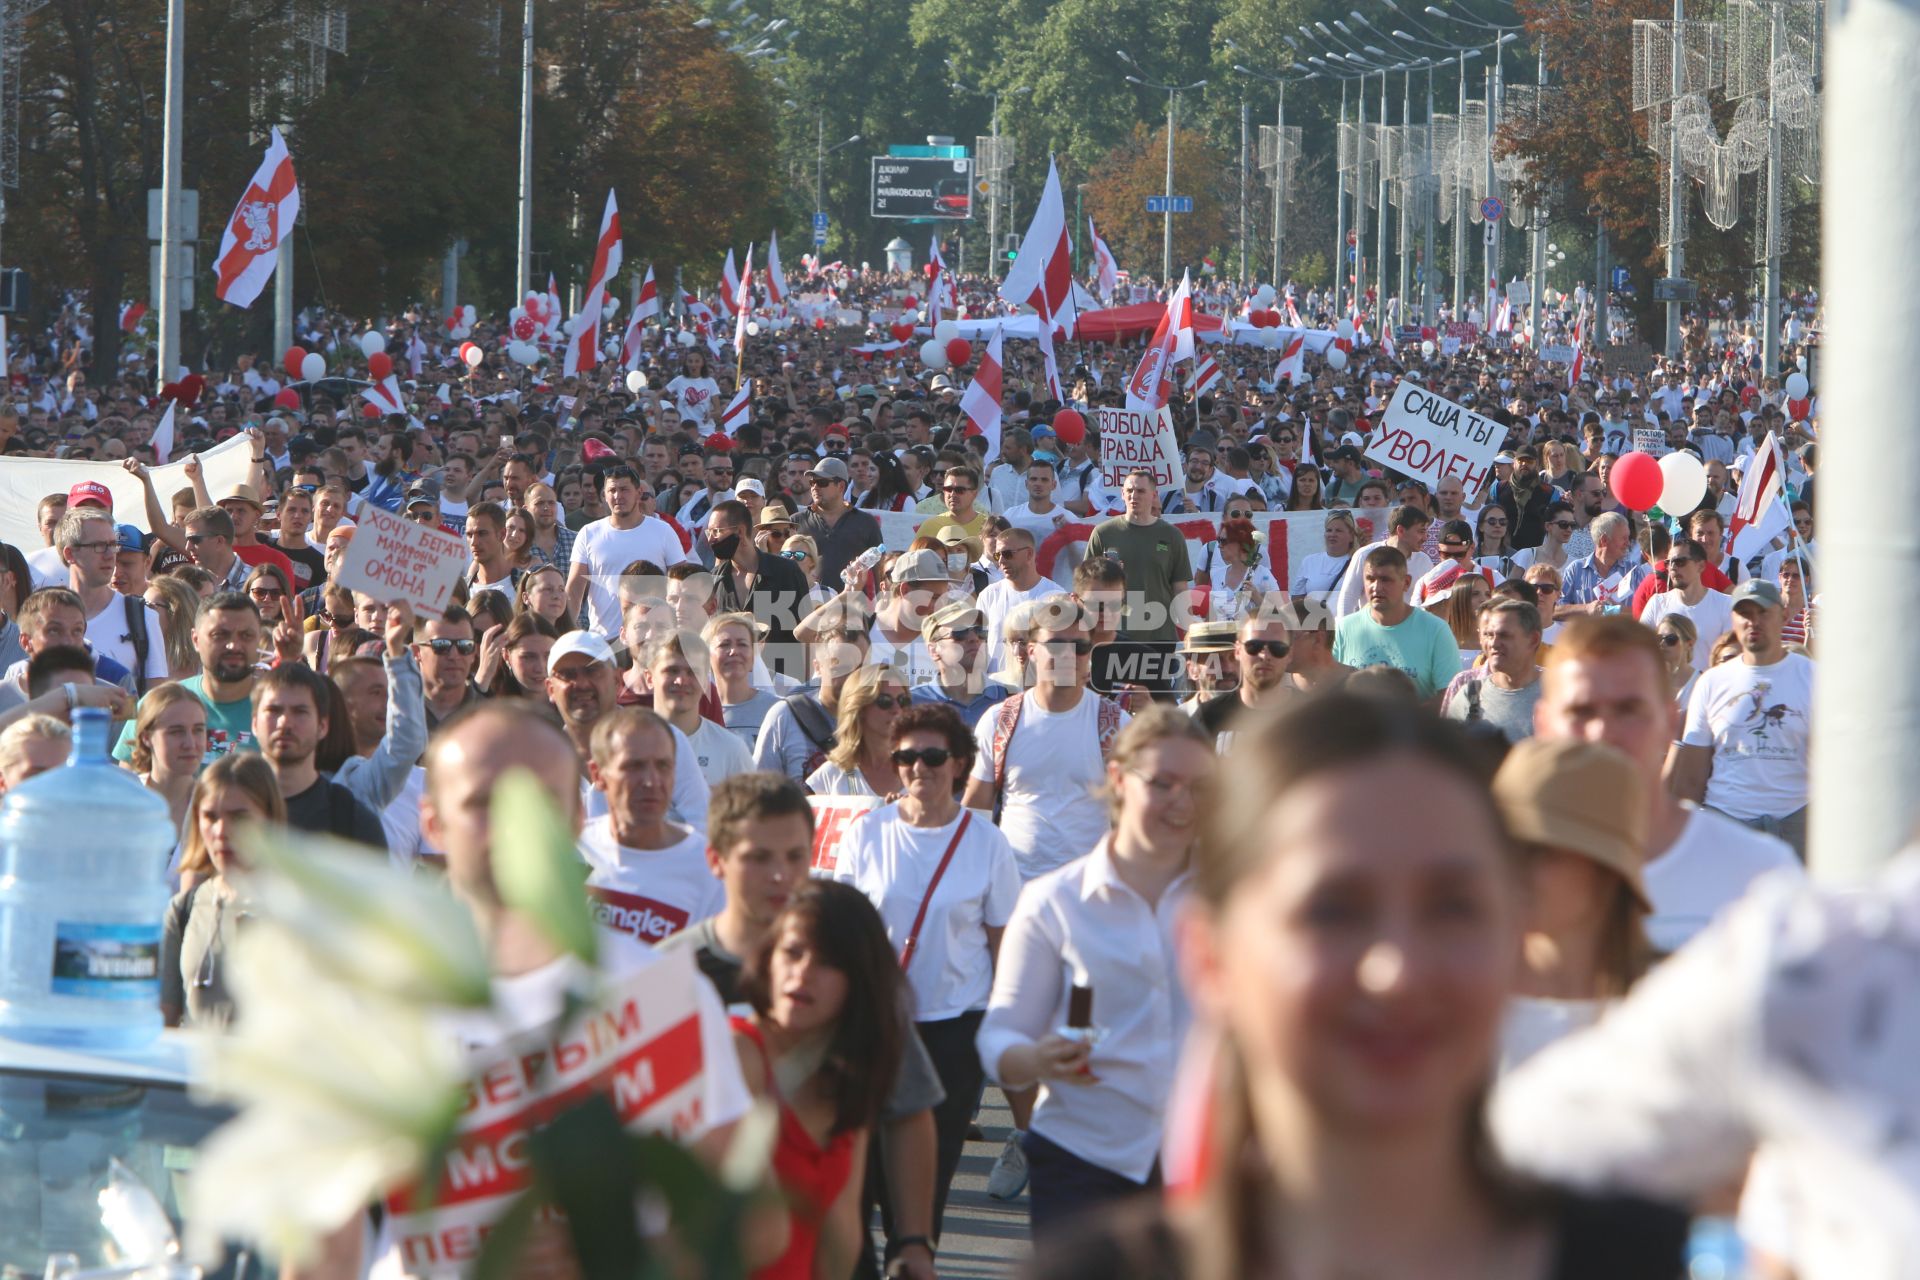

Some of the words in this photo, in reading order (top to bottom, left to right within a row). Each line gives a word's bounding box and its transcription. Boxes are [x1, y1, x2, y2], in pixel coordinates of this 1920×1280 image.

[1404, 390, 1460, 436] САША,
[1465, 415, 1495, 446] ТЫ
[1371, 421, 1488, 495] УВОЛЕН
[365, 511, 411, 540] ХОЧУ
[418, 532, 466, 559] БЕГАТЬ
[365, 559, 425, 597] ОМОНА
